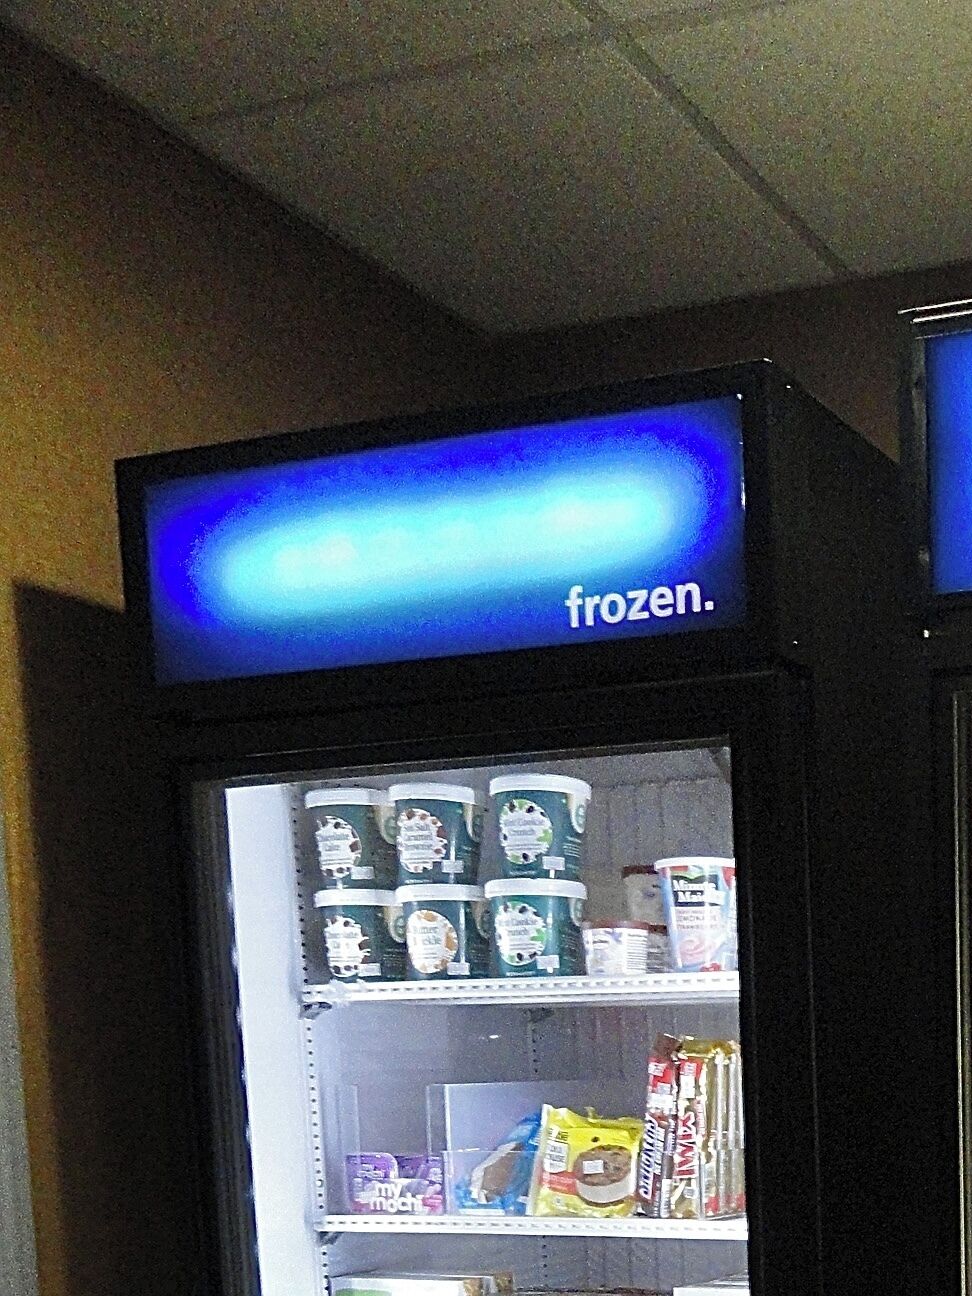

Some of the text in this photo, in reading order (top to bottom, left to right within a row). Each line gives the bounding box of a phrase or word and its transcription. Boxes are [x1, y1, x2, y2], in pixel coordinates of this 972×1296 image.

[564, 583, 715, 628] frozen.
[674, 1111, 698, 1179] TWIX
[374, 1182, 403, 1201] my
